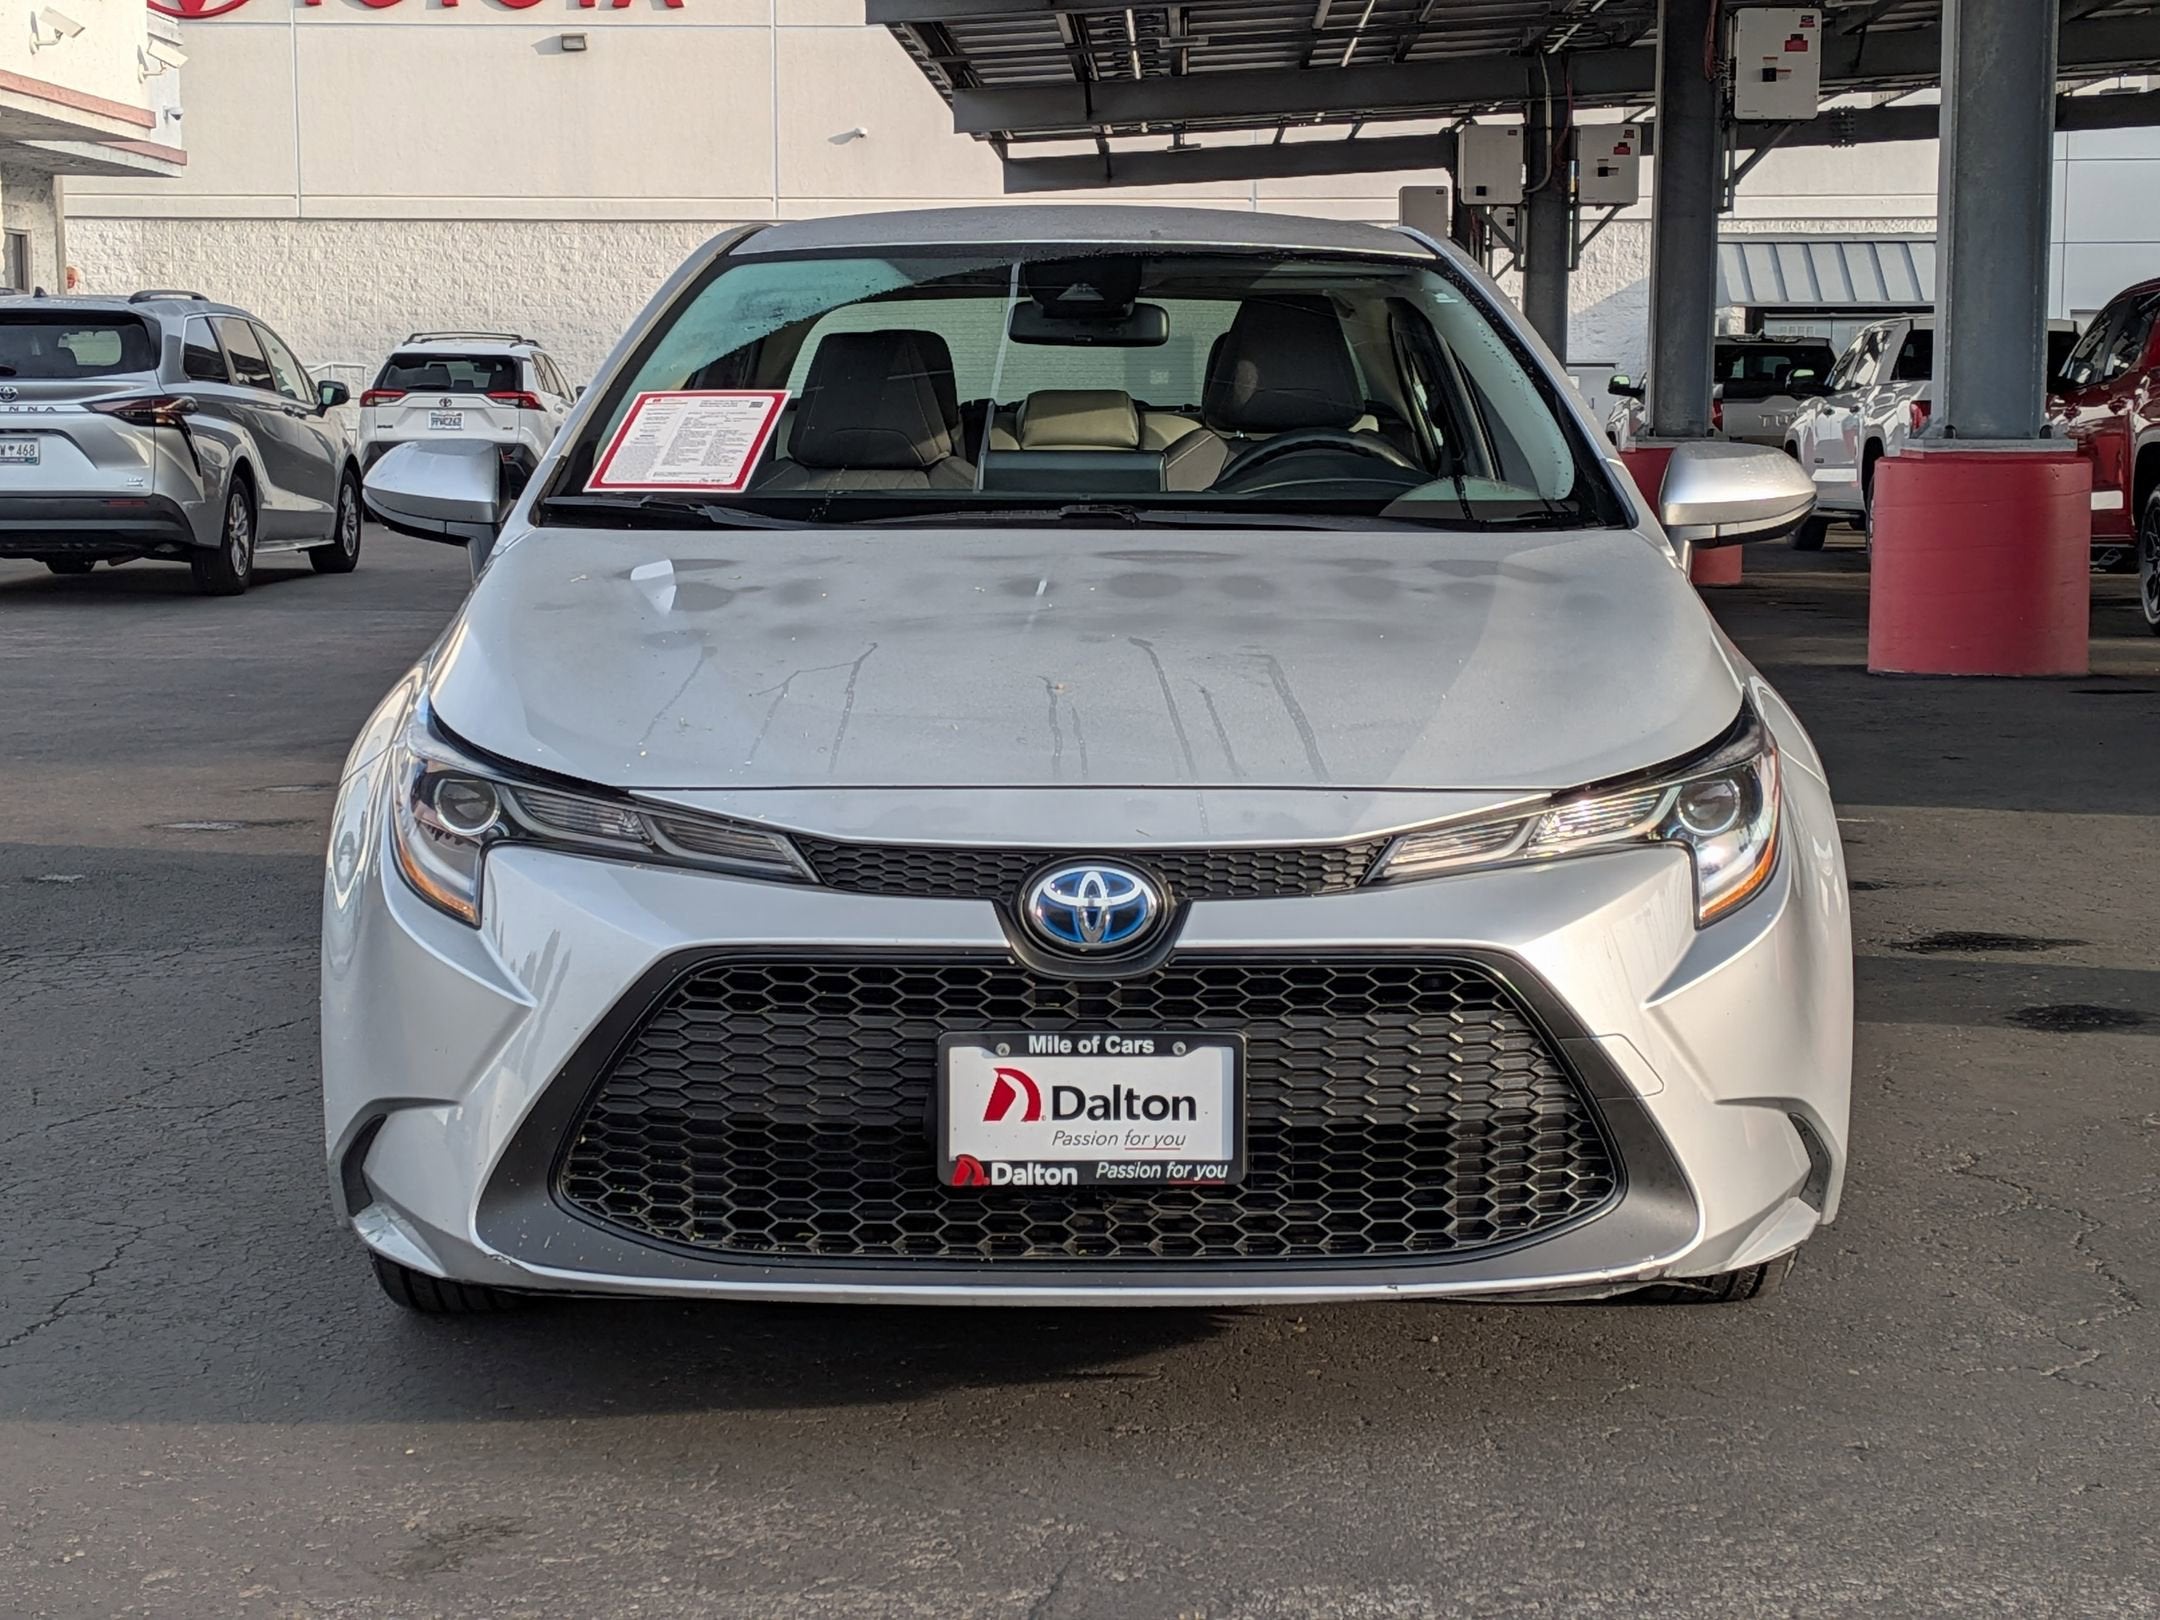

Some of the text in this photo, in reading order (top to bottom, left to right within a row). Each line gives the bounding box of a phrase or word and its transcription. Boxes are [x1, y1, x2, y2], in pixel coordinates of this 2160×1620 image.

[16, 443, 36, 457] 468
[1028, 1035, 1155, 1054] Mile of Cars
[1052, 1084, 1197, 1121] Dalton
[1052, 1129, 1186, 1149] Passion for you
[991, 1162, 1078, 1186] Dalton
[1095, 1161, 1228, 1181] Passion for you
